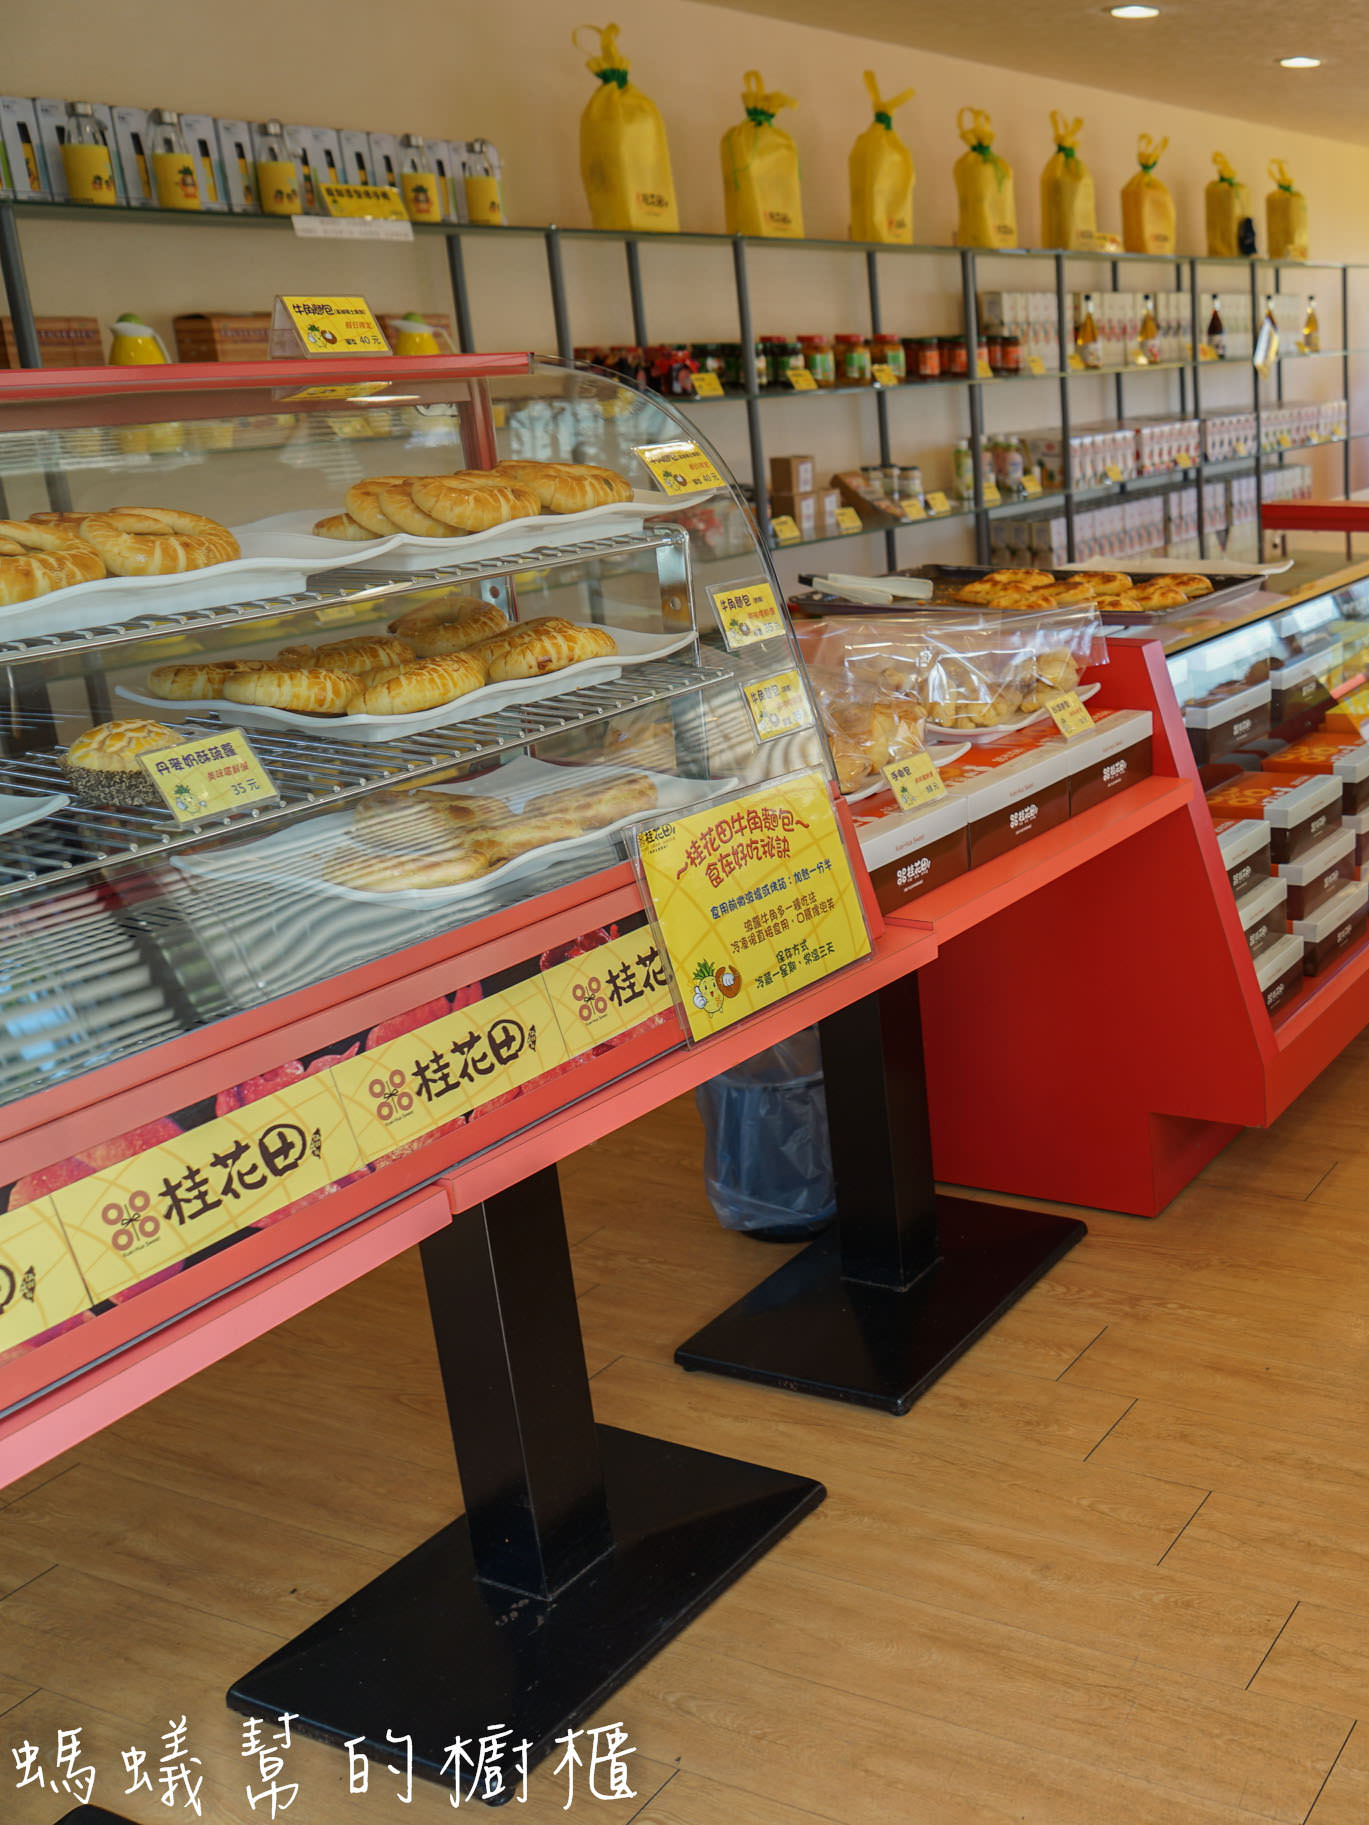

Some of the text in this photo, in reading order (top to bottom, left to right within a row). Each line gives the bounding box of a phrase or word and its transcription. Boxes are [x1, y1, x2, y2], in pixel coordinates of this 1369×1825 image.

[359, 336, 370, 345] 40
[371, 335, 382, 345] 元
[231, 778, 260, 796] 35 元
[705, 835, 791, 889] 食在好吃秘訣
[776, 938, 810, 964] 保存方式
[411, 1018, 526, 1103] 桂花田
[158, 1122, 307, 1226] 桂花田
